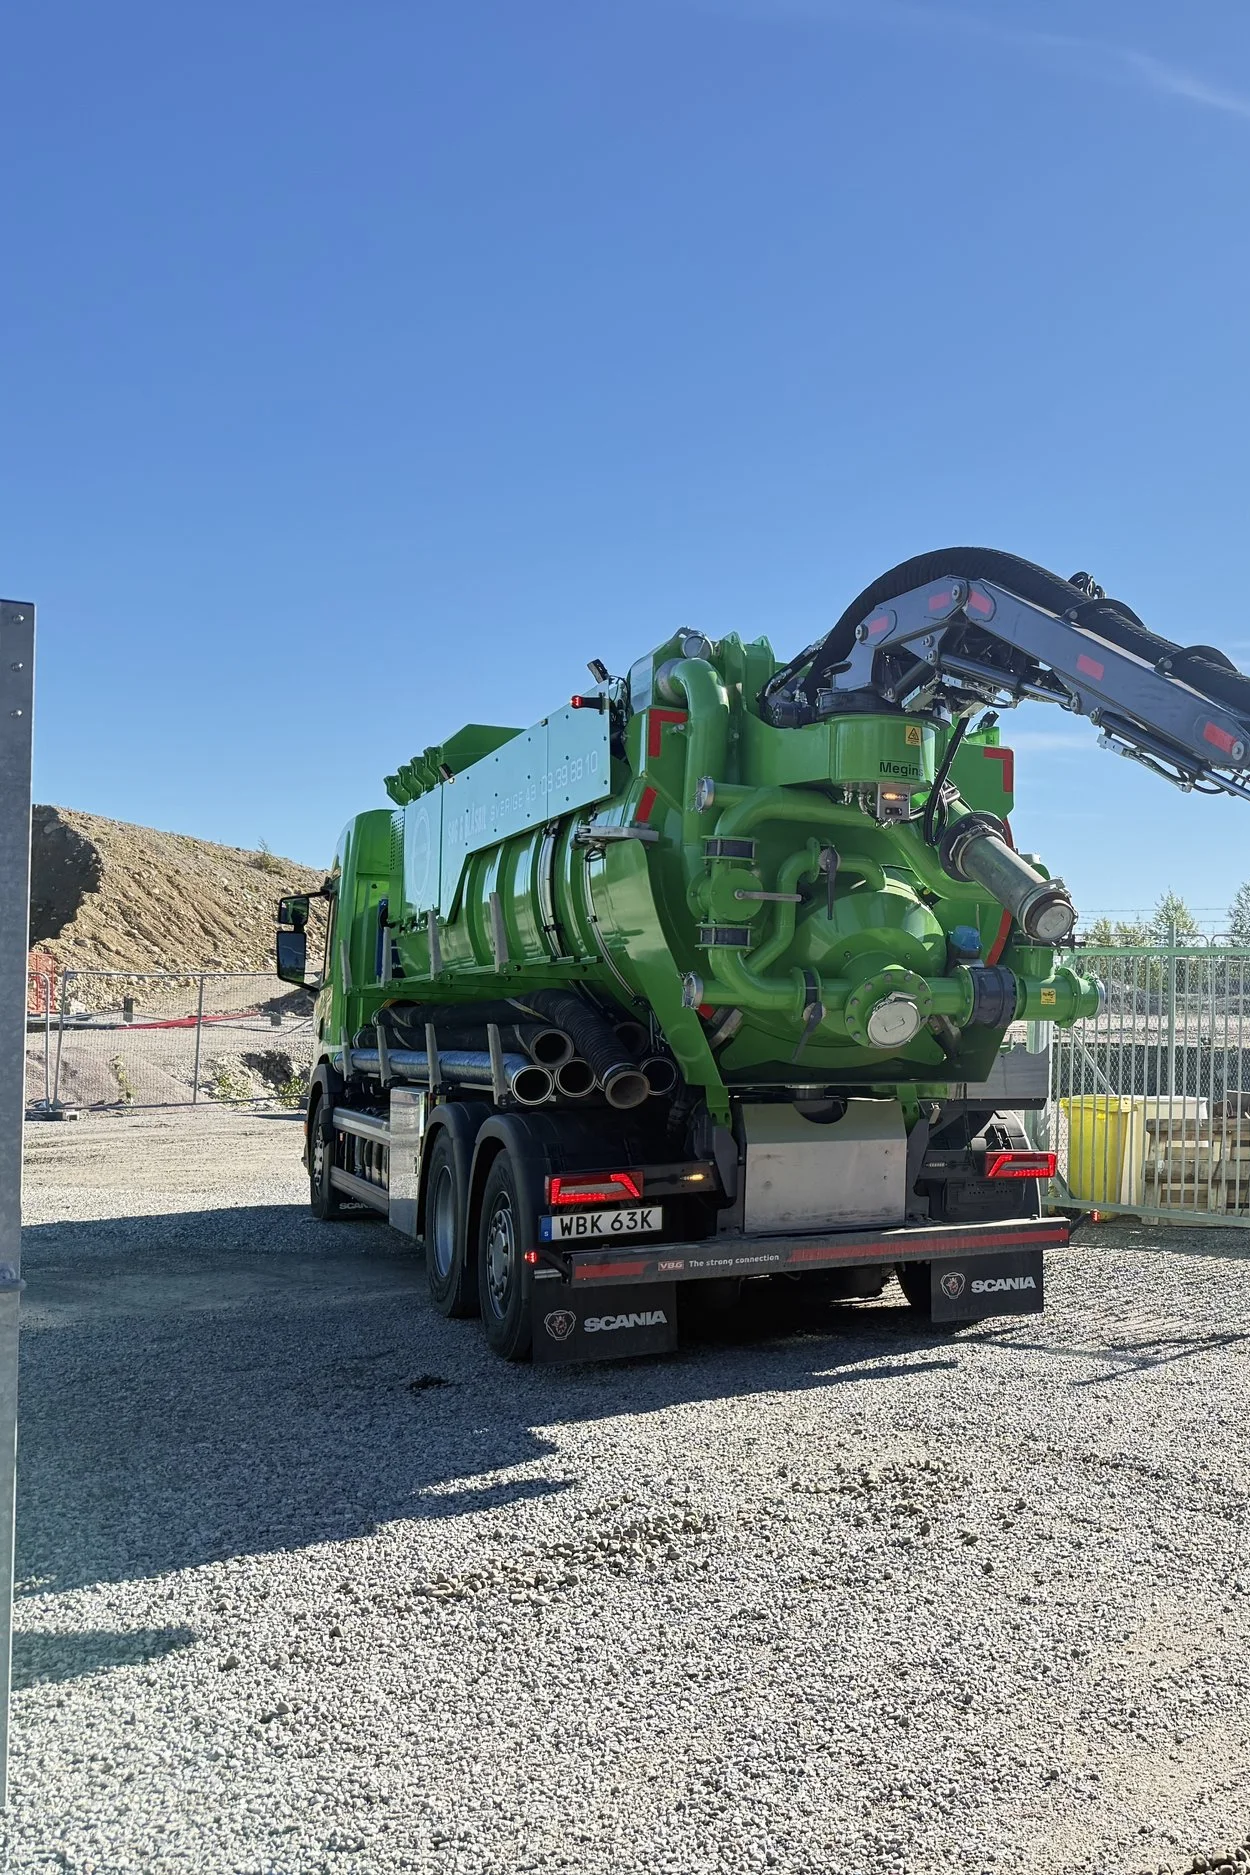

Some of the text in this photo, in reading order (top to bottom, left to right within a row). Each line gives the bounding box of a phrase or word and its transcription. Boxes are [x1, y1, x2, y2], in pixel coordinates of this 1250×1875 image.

[585, 750, 598, 775] 10
[339, 1202, 374, 1210] SCAN
[560, 1214, 602, 1237] WBK
[611, 1210, 652, 1231] 63K
[660, 1253, 780, 1270] VBG The strong connection
[971, 1276, 1037, 1294] SCANIA
[584, 1310, 668, 1332] SCANIA
